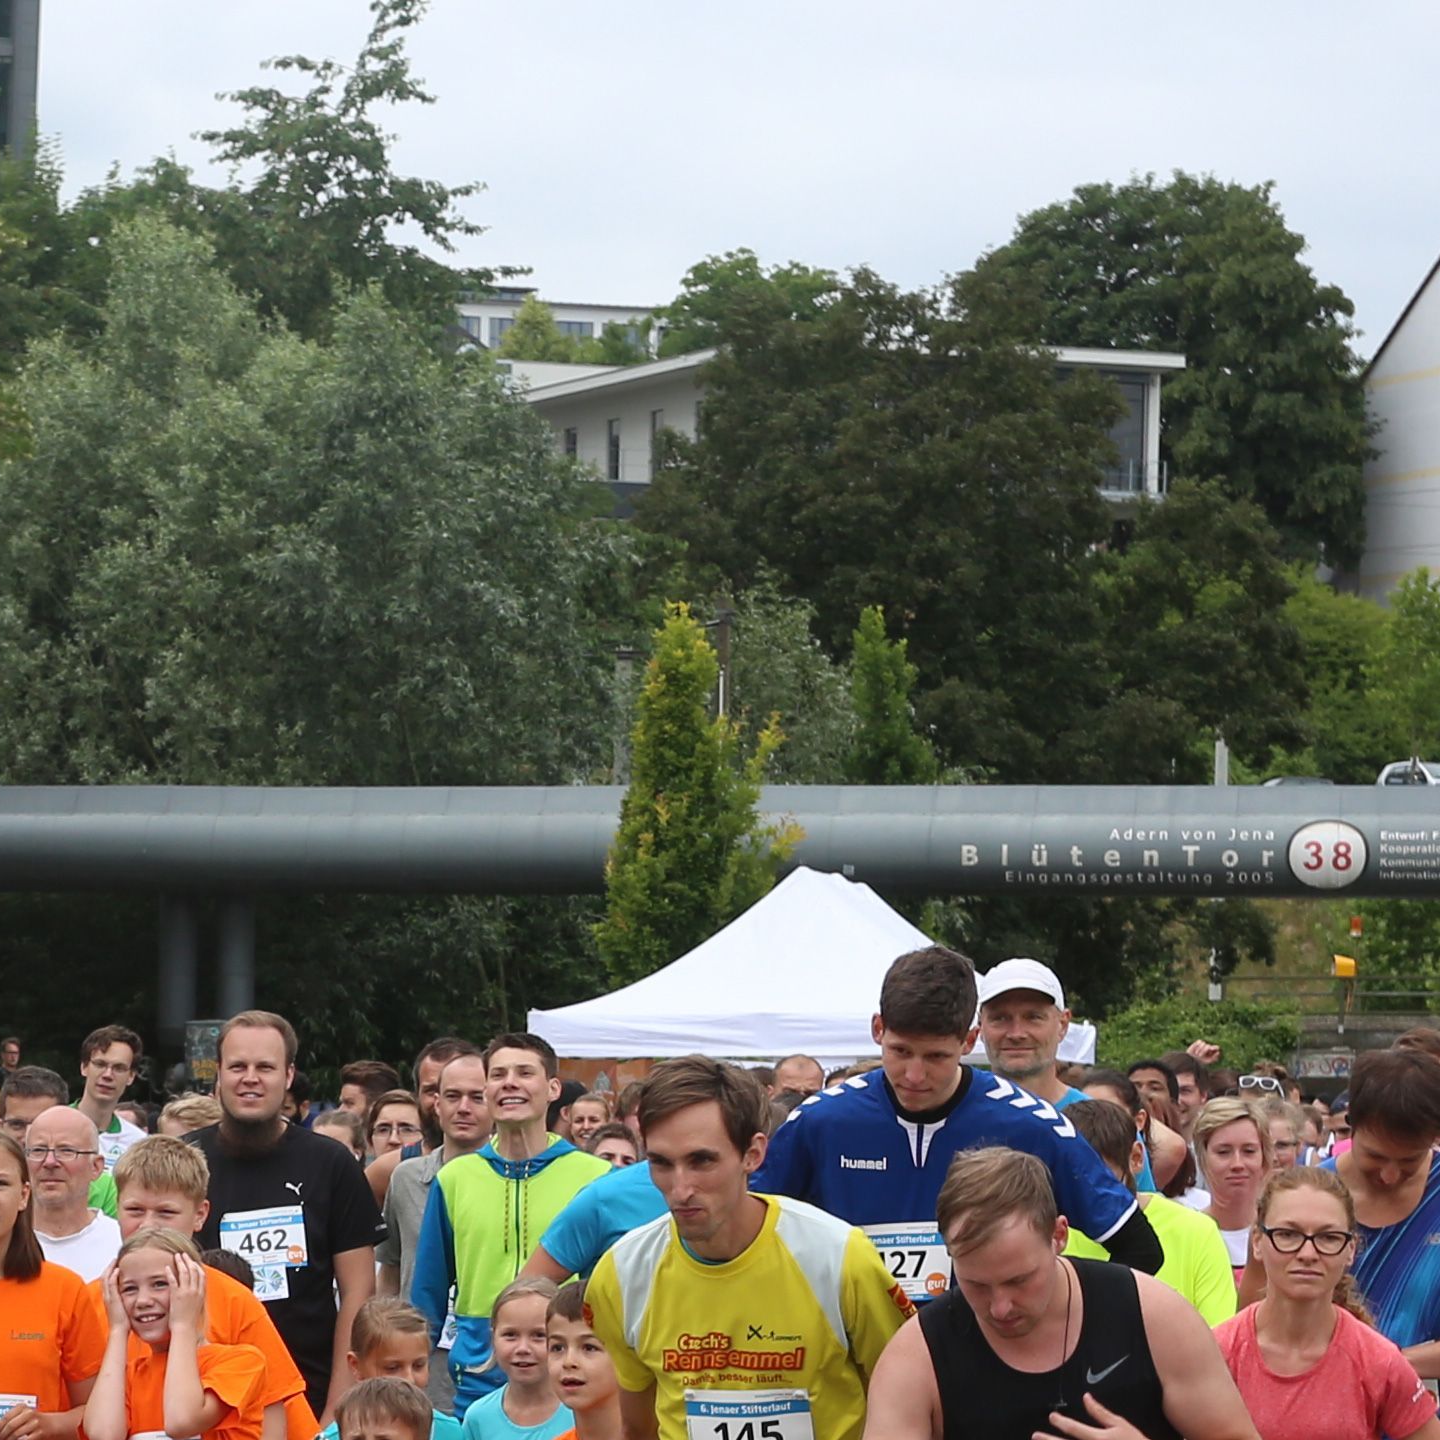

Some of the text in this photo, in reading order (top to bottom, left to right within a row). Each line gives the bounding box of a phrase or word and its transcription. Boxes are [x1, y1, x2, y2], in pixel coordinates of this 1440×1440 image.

[1109, 828, 1275, 841] Adern von Jena
[1302, 840, 1353, 871] 38
[1224, 871, 1275, 884] 2005
[840, 1154, 887, 1170] hummel
[239, 1228, 289, 1254] 462
[679, 1333, 730, 1350] Czech's
[664, 1348, 804, 1370] Rennsemmel
[719, 1373, 753, 1384] besser
[700, 1401, 791, 1415] 6. Jenaer Stifterlauf
